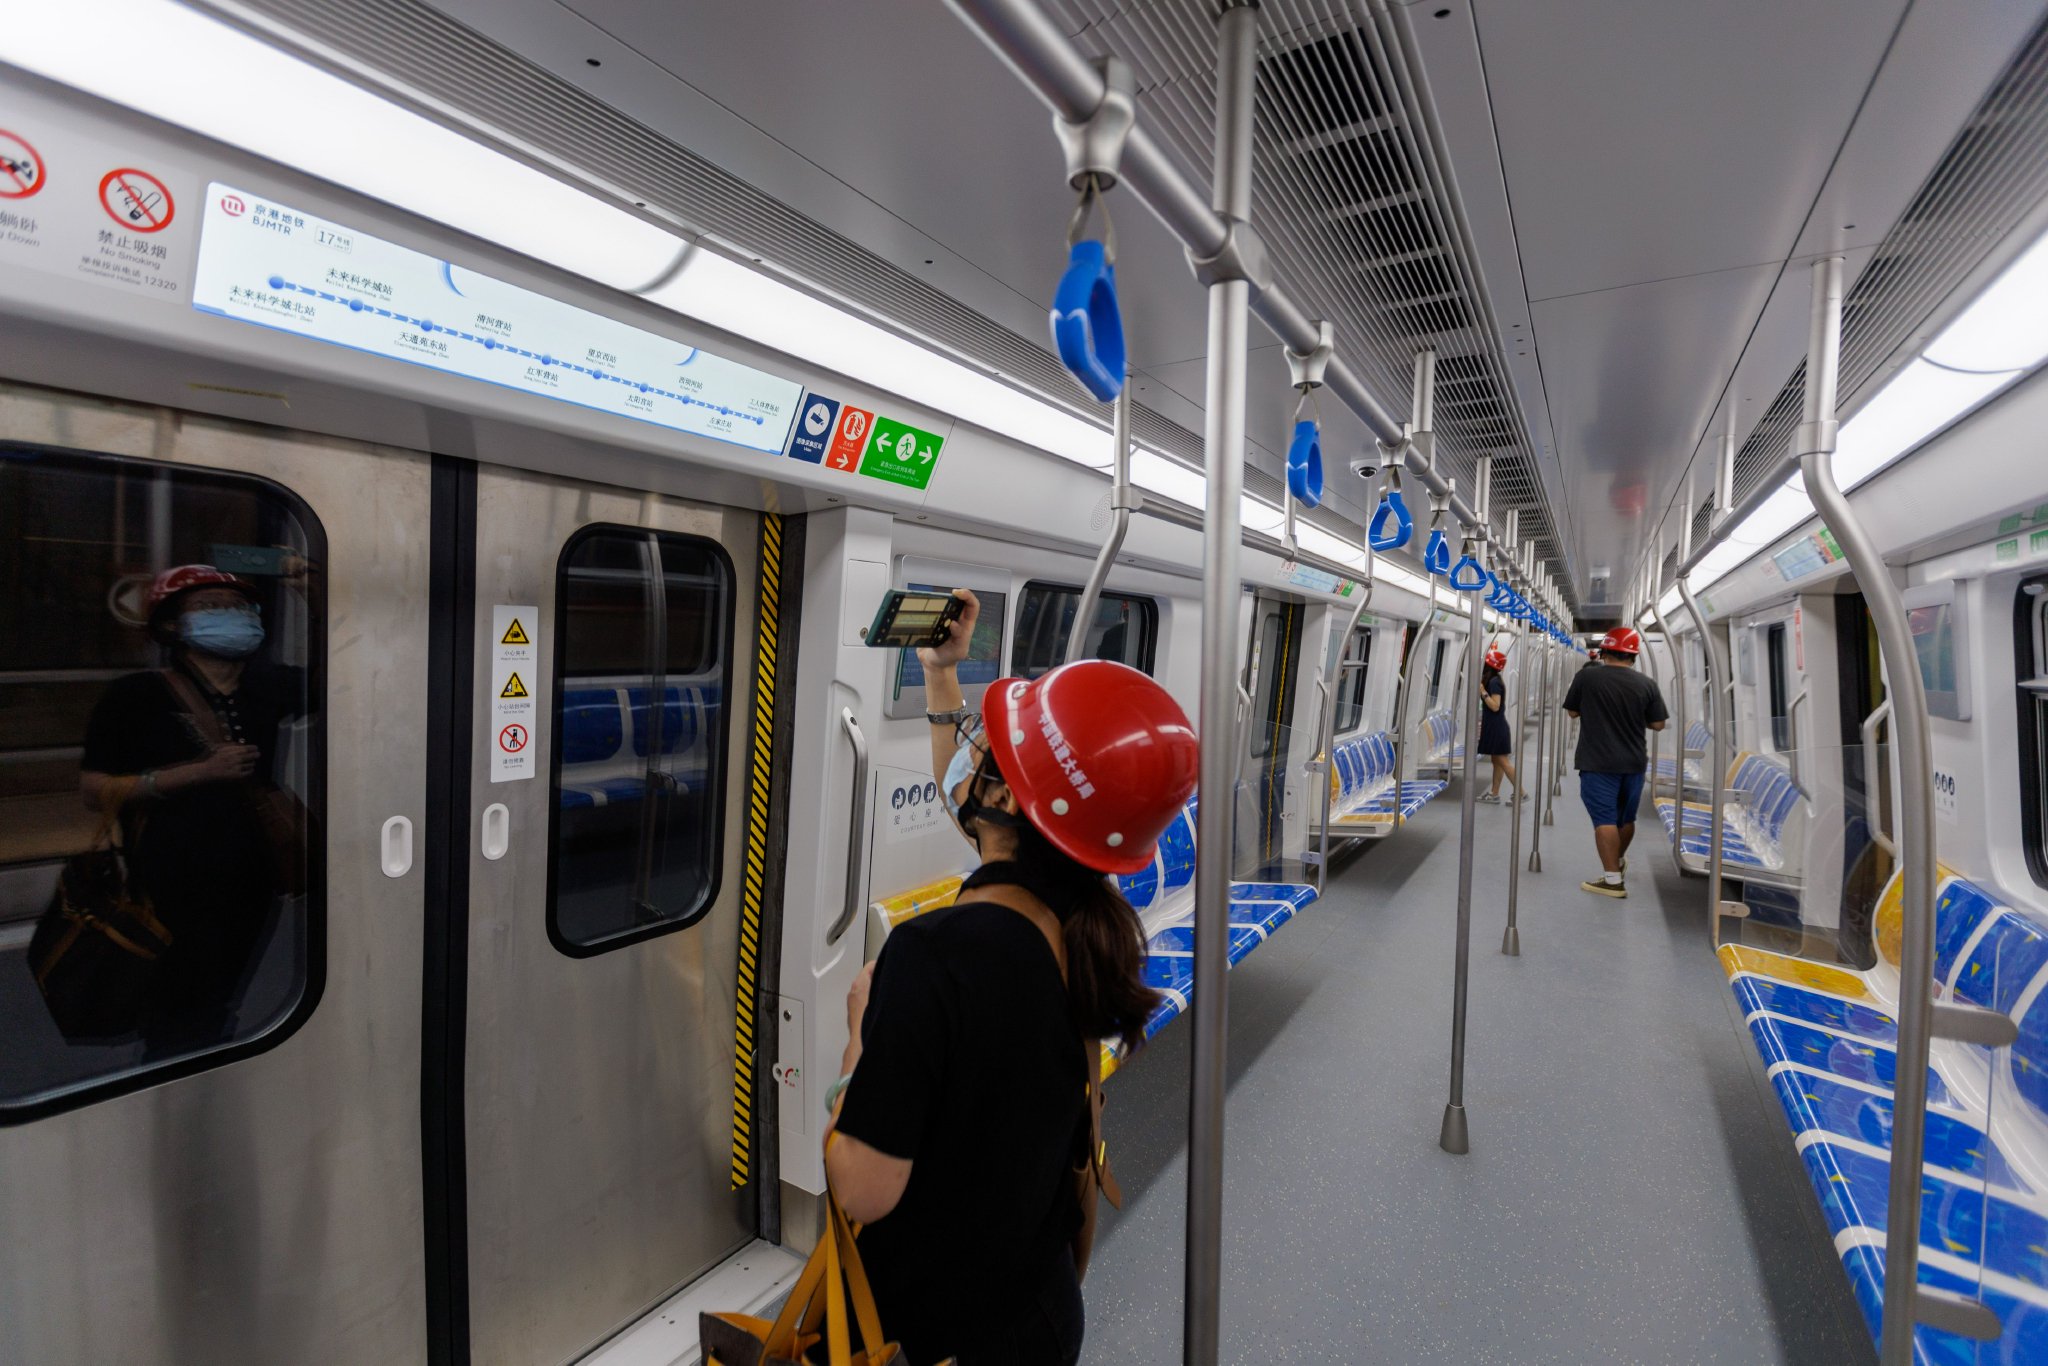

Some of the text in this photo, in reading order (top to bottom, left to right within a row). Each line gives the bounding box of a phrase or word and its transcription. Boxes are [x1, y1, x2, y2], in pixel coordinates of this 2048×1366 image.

[252, 215, 292, 236] BJMTR
[255, 204, 305, 229] 京港地铁
[99, 229, 167, 260] 禁止吸烟
[100, 246, 161, 270] No Smoking
[145, 275, 177, 291] 12320
[327, 267, 394, 296] 未来科学城站
[229, 284, 316, 317] 未来科学城北站
[399, 332, 448, 353] 天通苑东站
